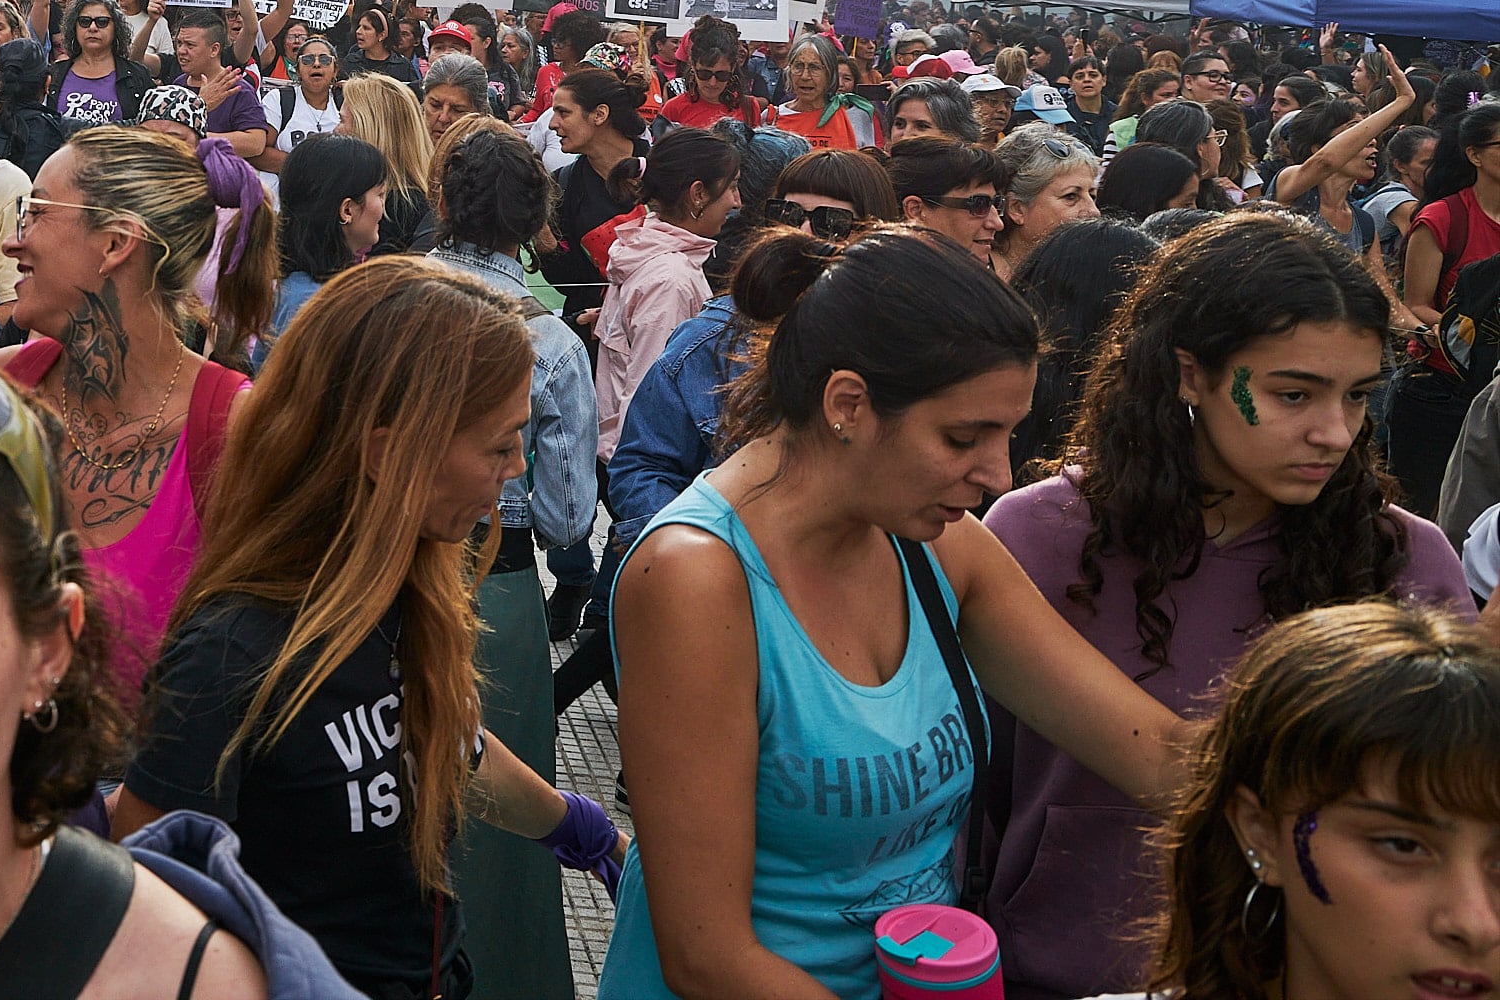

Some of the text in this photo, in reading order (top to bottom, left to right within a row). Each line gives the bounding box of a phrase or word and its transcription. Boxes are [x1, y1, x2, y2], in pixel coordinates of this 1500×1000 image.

[628, 0, 649, 10] CSC
[347, 771, 401, 833] IS
[773, 742, 931, 818] SHINE
[866, 803, 947, 867] LIKE
